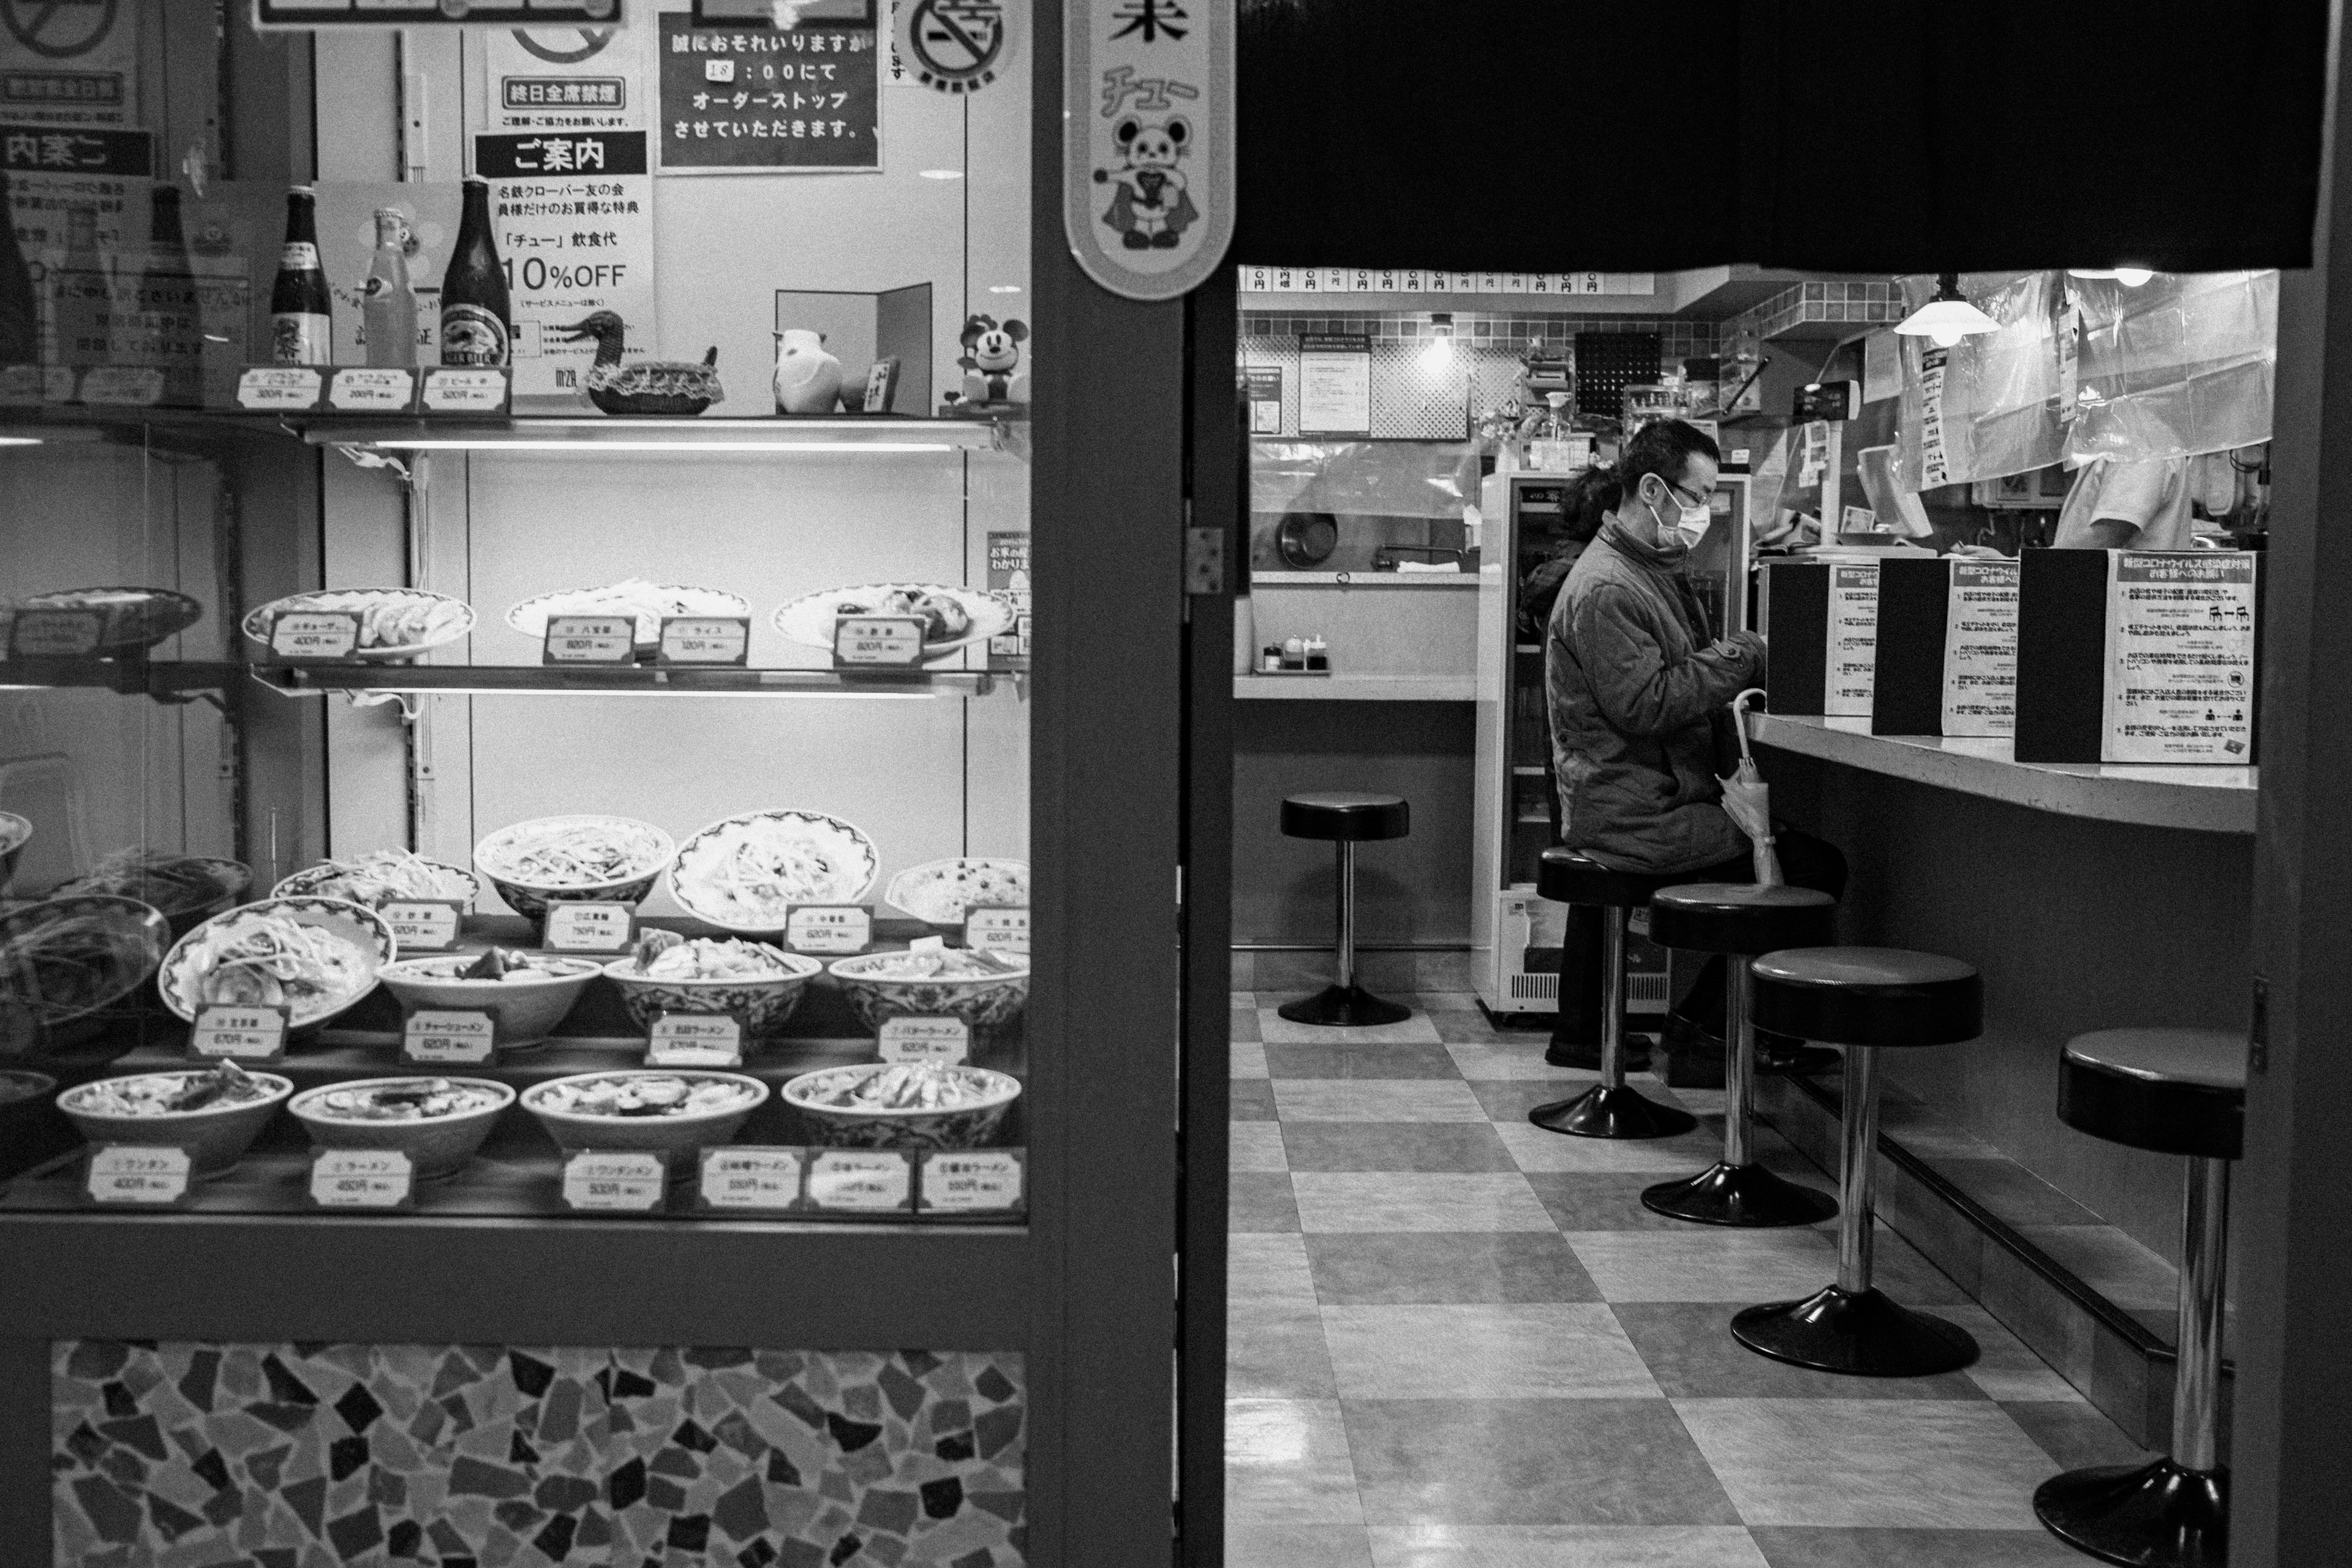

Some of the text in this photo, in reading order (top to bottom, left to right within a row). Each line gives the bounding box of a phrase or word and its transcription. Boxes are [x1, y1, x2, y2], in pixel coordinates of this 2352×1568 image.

[693, 92, 848, 110] オーダーストップ
[674, 120, 856, 139] させていただきます。
[515, 137, 605, 171] ご案内
[499, 183, 624, 198] 名鉄クローバー友の会
[502, 257, 627, 290] 10%OFF
